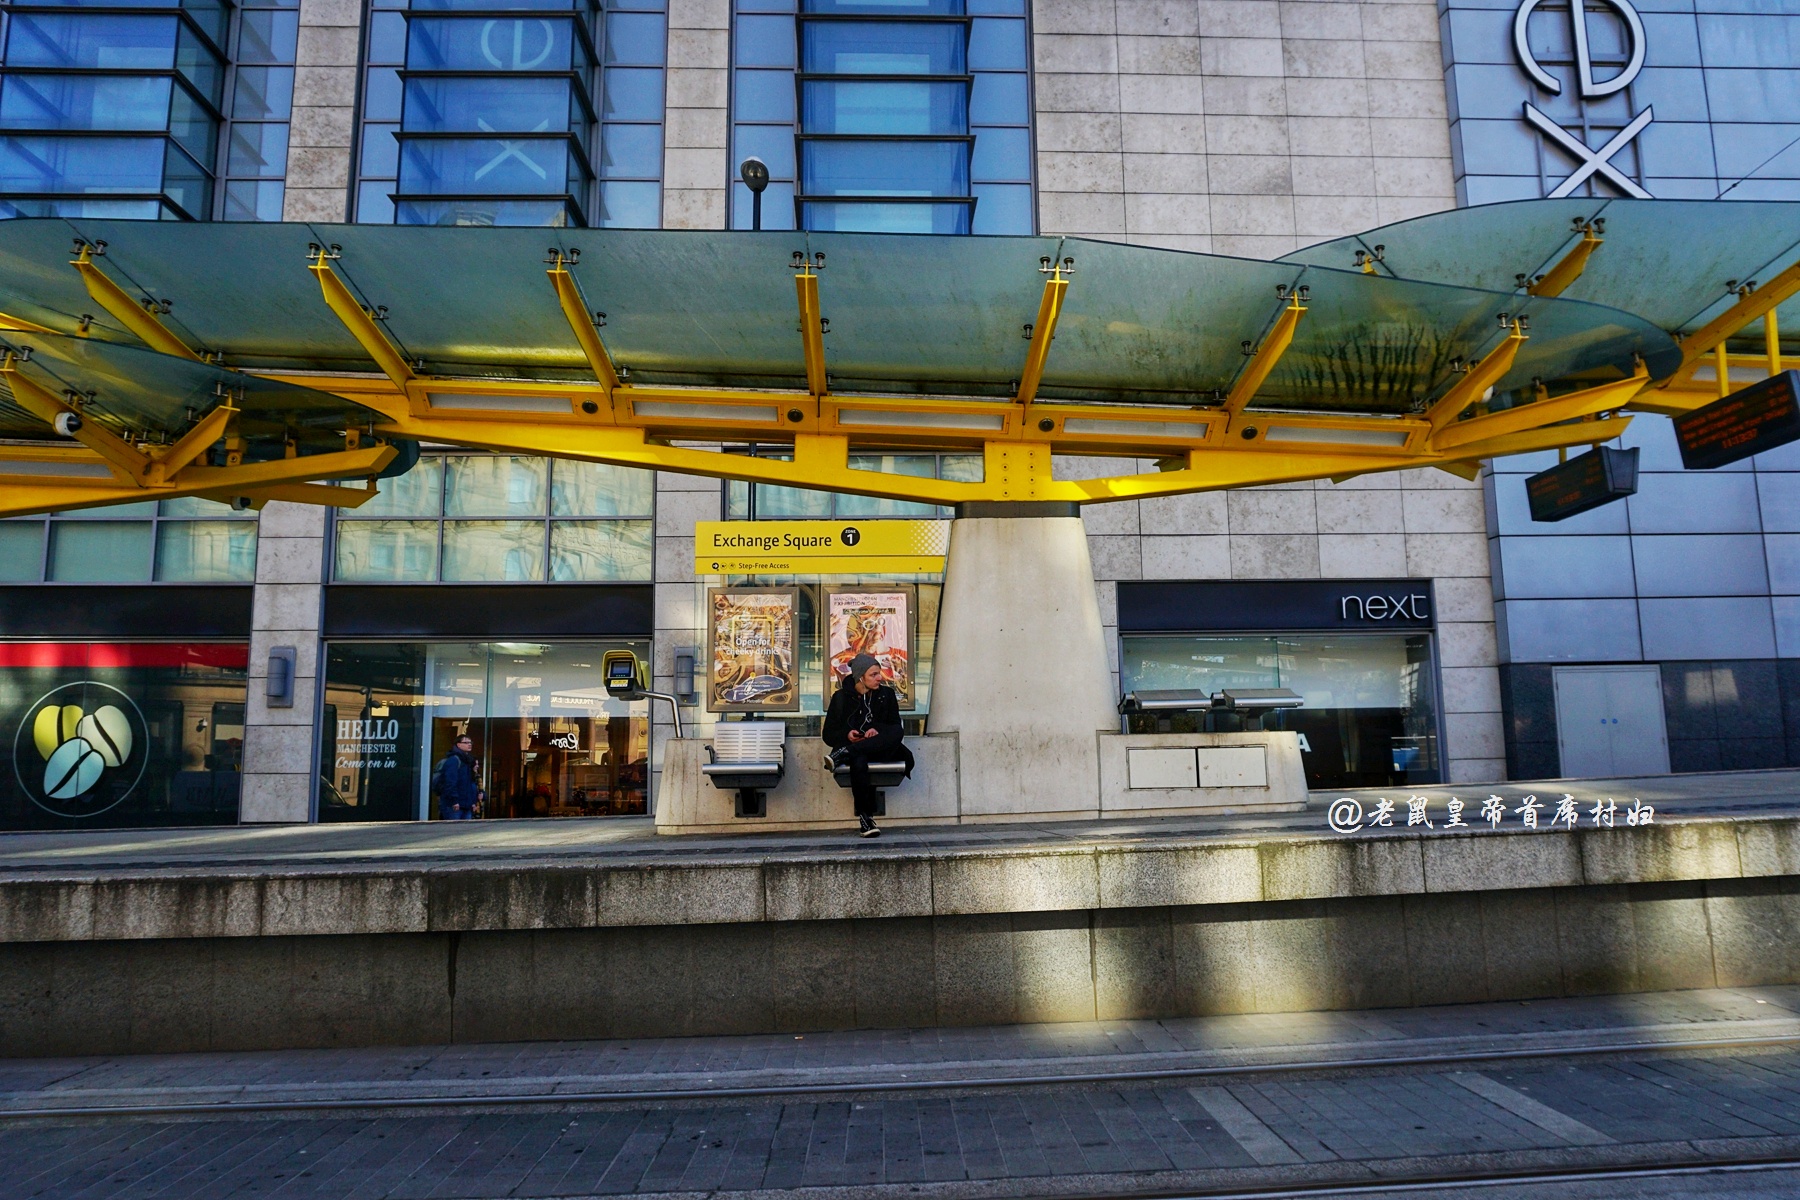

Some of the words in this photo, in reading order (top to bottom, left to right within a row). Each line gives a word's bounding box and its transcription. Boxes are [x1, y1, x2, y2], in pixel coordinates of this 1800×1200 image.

[713, 533, 780, 551] Exchange
[783, 533, 832, 551] Square
[846, 534, 853, 545] 1
[738, 562, 768, 571] Step-Free
[769, 562, 790, 570] Access
[1341, 593, 1428, 620] next
[735, 638, 758, 647] Open
[758, 638, 771, 646] for
[726, 648, 754, 657] cheeky
[754, 648, 779, 656] drinks
[336, 719, 399, 740] HELLO
[336, 744, 396, 753] MANCHESTER
[335, 756, 365, 769] Come
[367, 760, 382, 769] on
[384, 756, 397, 769] in
